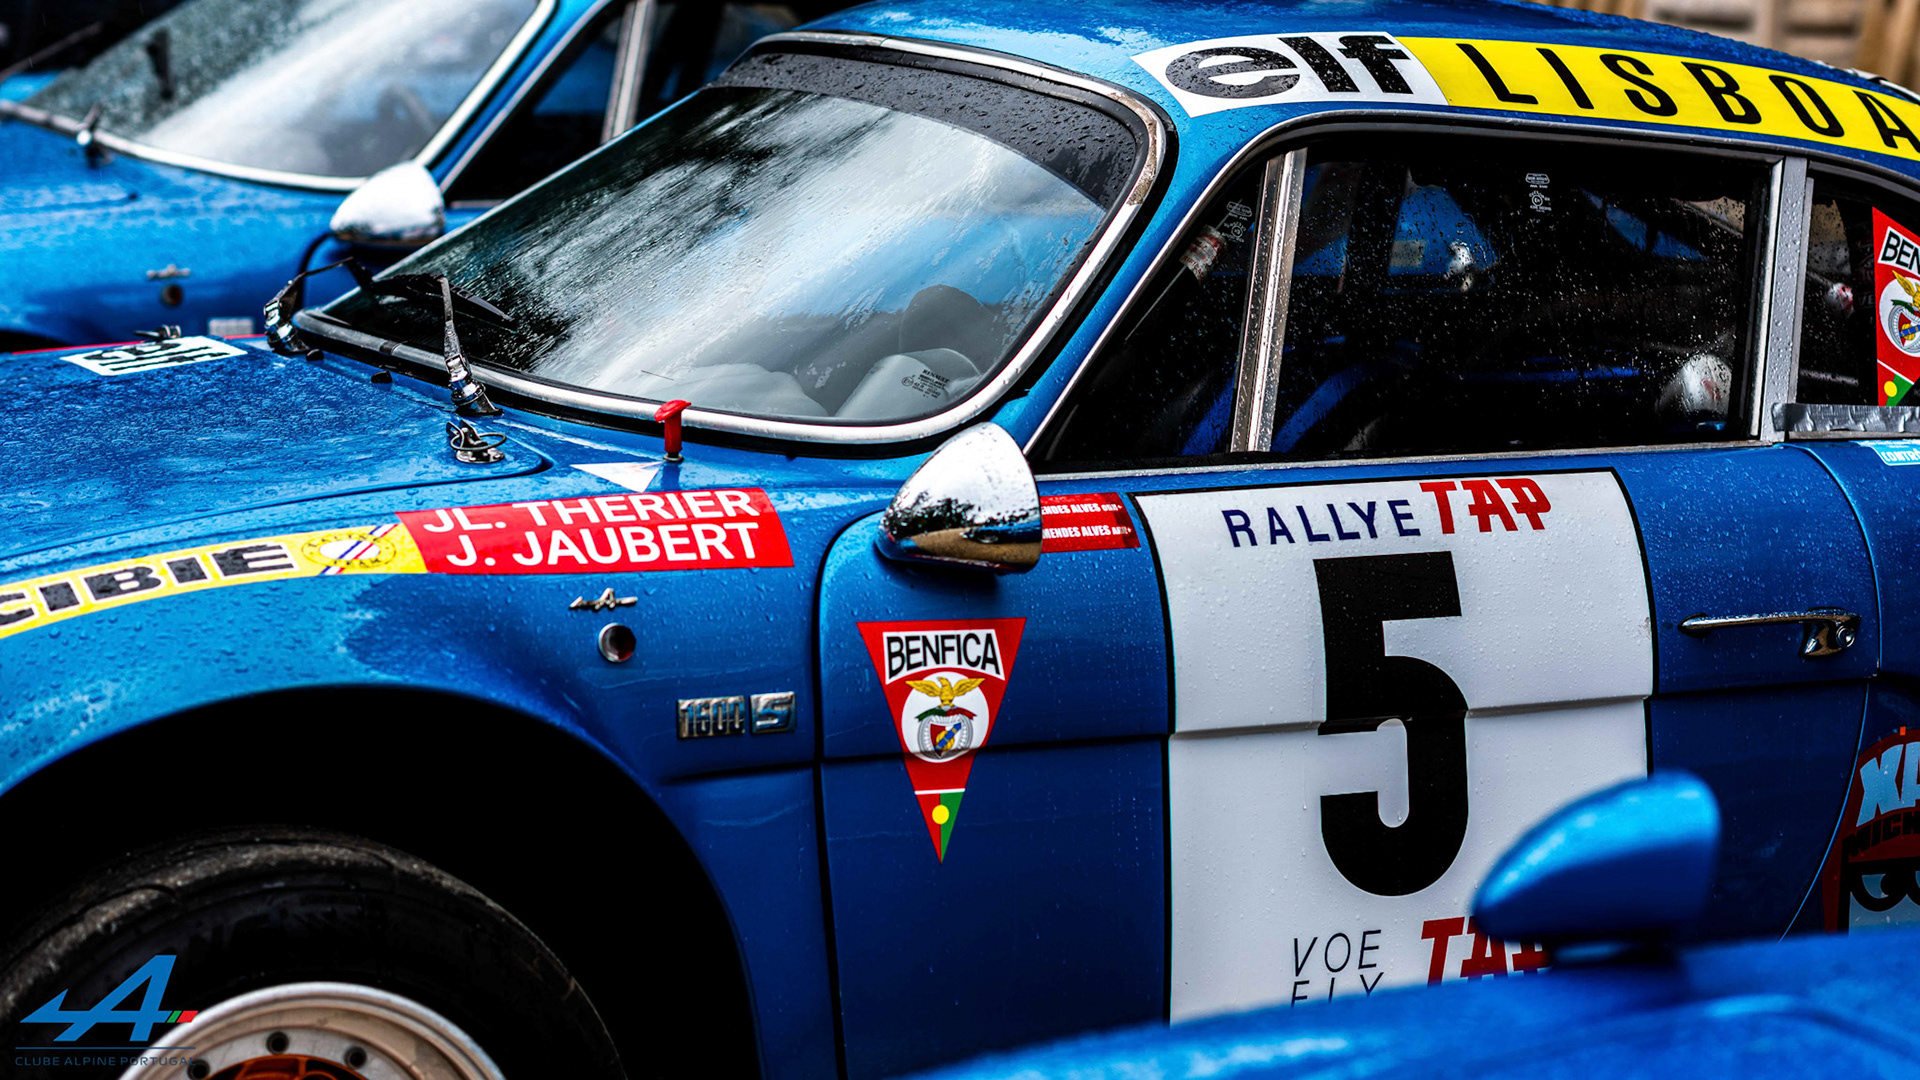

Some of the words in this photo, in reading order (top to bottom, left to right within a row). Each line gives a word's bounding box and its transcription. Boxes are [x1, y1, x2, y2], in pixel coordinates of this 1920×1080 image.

[1165, 35, 1414, 98] elf
[1459, 43, 1920, 153] LISBOA
[424, 508, 507, 533] JL.
[513, 490, 761, 527] THERIER
[1070, 503, 1101, 514] ALVES
[1081, 525, 1111, 537] ALVES
[1222, 499, 1421, 548] RALLYE
[1419, 478, 1552, 535] TAP
[446, 534, 497, 567] J.
[513, 522, 760, 567] JAUBERT
[886, 632, 1001, 680] BENFICA
[679, 697, 744, 738] 1600
[755, 693, 796, 733] S
[1313, 551, 1470, 897] 5
[1293, 929, 1382, 977] VOE
